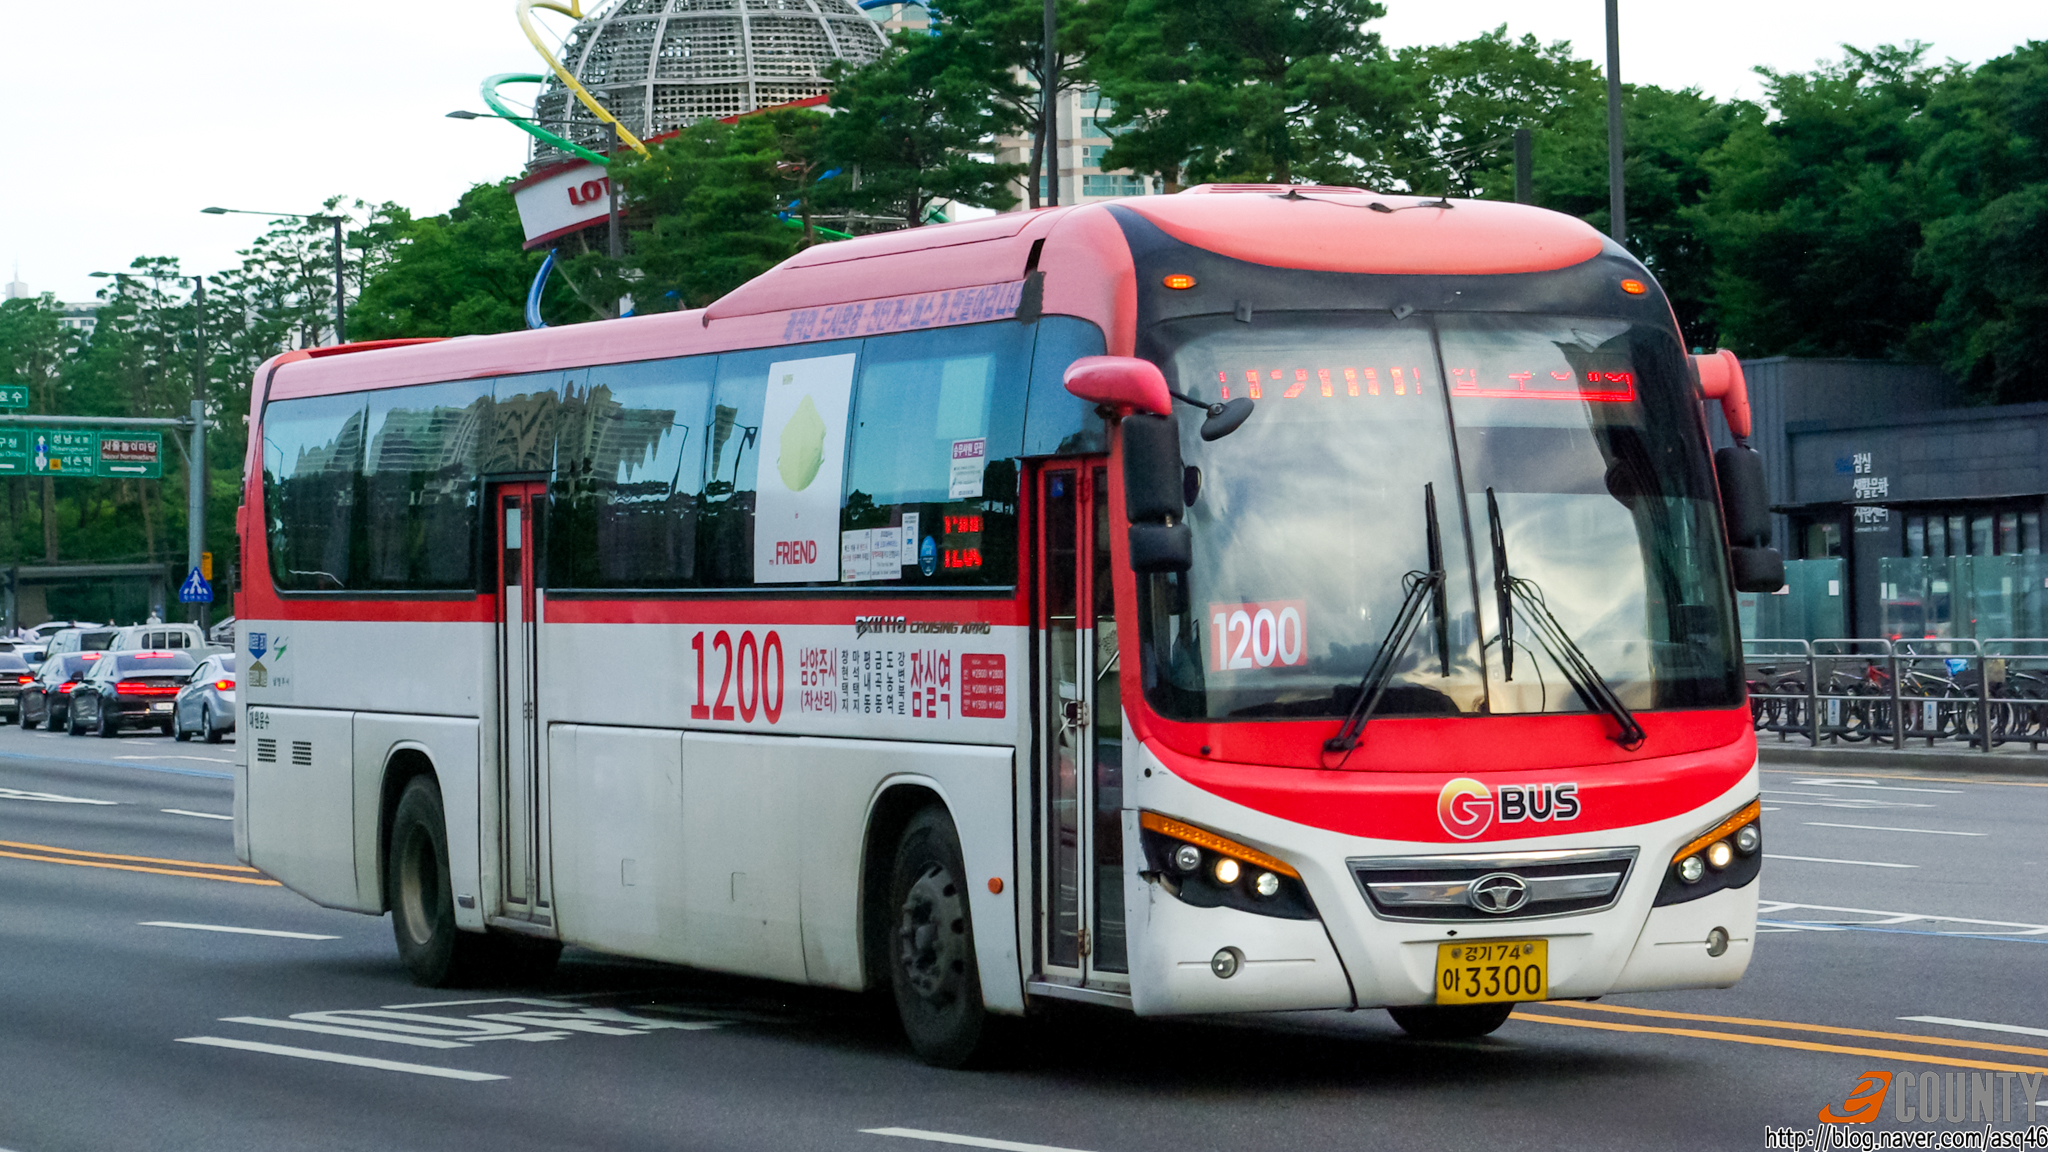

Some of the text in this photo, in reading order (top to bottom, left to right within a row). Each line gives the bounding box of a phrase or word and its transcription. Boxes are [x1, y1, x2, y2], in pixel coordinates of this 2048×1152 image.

[1853, 453, 1871, 474] 잠실
[1853, 477, 1888, 499] 생활문화
[776, 540, 817, 565] FRIEND
[1212, 606, 1300, 671] 1200
[691, 630, 784, 724] 1200
[800, 648, 837, 687] 남양주시
[863, 650, 871, 713] 평내동
[910, 649, 950, 720] 잠실역
[800, 690, 837, 714] (차산리)
[1498, 783, 1581, 823] BUS
[1465, 945, 1521, 962] 경기 74
